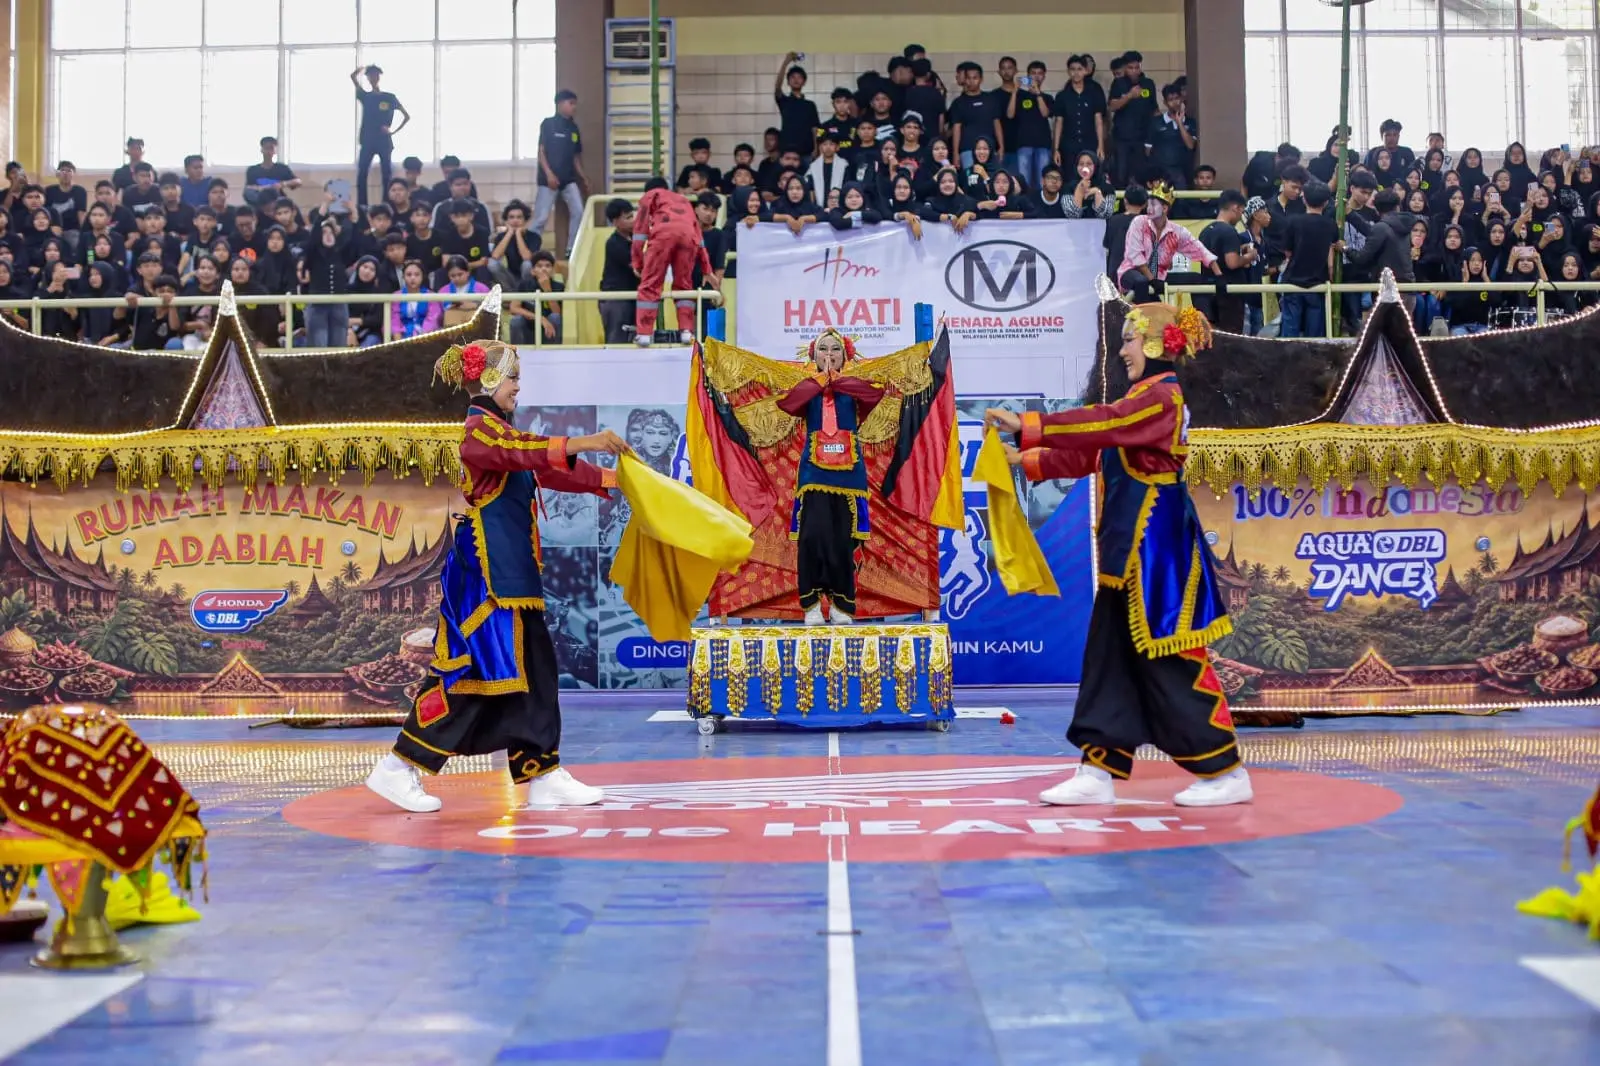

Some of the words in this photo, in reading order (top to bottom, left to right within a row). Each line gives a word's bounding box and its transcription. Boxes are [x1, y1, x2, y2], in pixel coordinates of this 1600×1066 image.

[784, 298, 901, 326] HAYATI
[1008, 316, 1064, 327] AGUNG
[75, 483, 227, 546] RUMAH
[240, 481, 403, 540] MAKAN
[1234, 484, 1316, 520] 100%
[152, 534, 325, 570] ADABIAH
[1297, 533, 1372, 560] AQUA
[1396, 536, 1439, 552] DBL
[1312, 562, 1424, 608] DANCE
[216, 599, 264, 607] HONDA
[217, 613, 240, 624] DBL
[984, 641, 1044, 653] KAMU
[510, 797, 1166, 811] HOND
[477, 825, 730, 839] One
[763, 816, 1207, 837] HEART.
